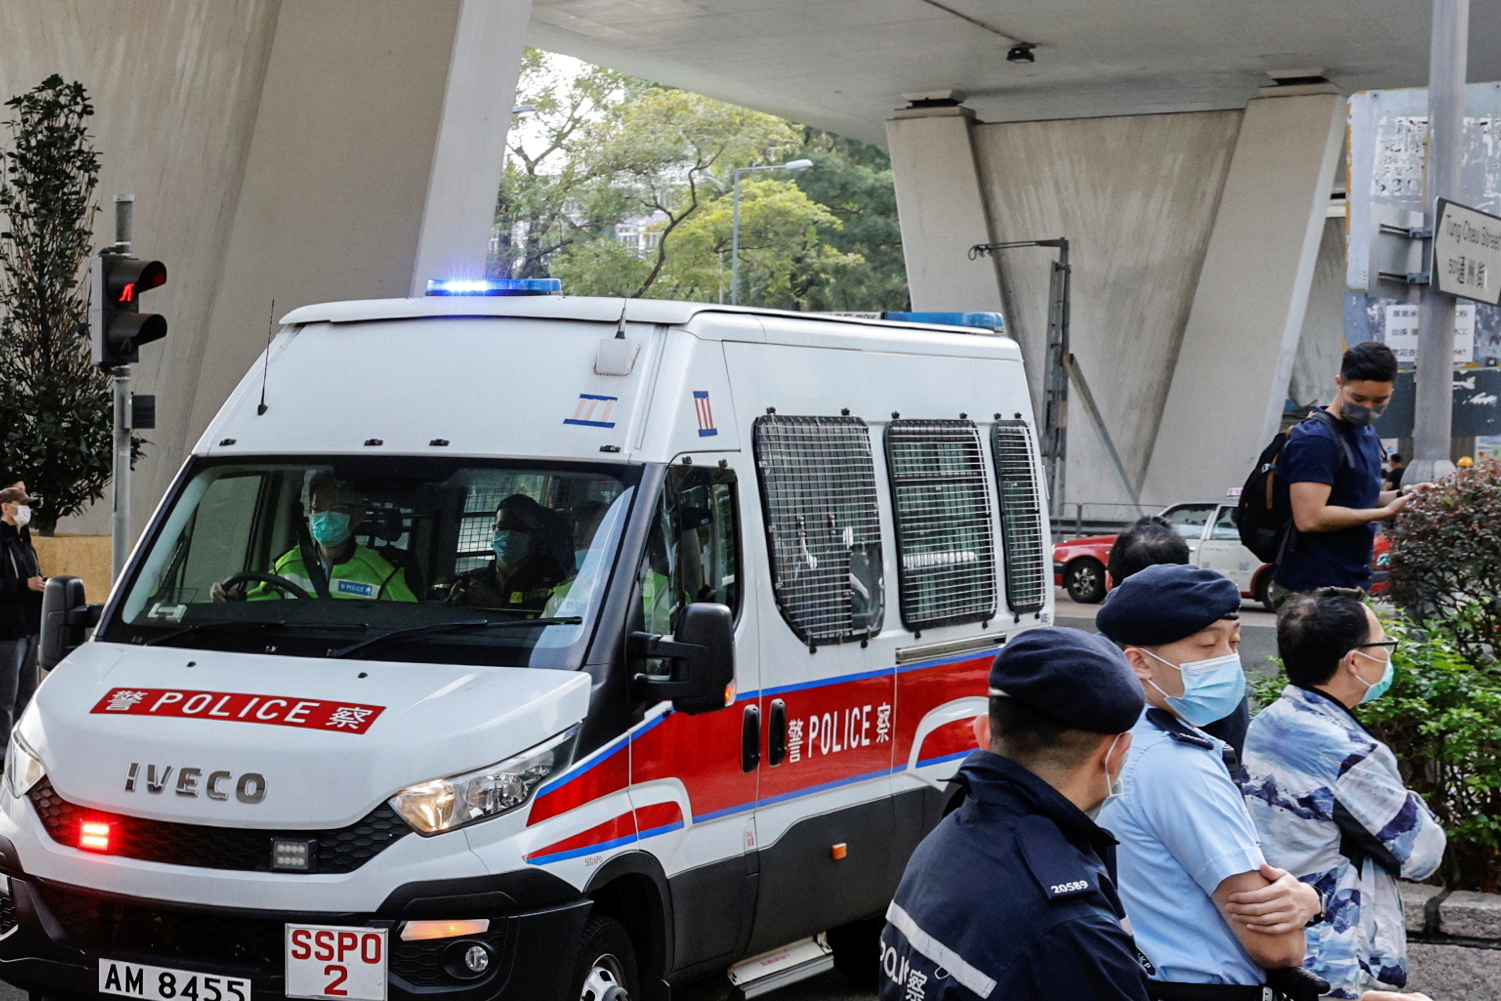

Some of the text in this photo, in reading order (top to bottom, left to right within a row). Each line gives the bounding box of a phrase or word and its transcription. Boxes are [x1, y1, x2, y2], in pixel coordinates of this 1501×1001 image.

[105, 690, 374, 730] 警 POLICE 察
[787, 702, 891, 763] 警 POLICE 察
[124, 762, 268, 804] IVECO
[1050, 880, 1089, 894] 20589
[291, 930, 381, 964] SSPO
[104, 963, 144, 995] AM
[324, 965, 348, 996] 2
